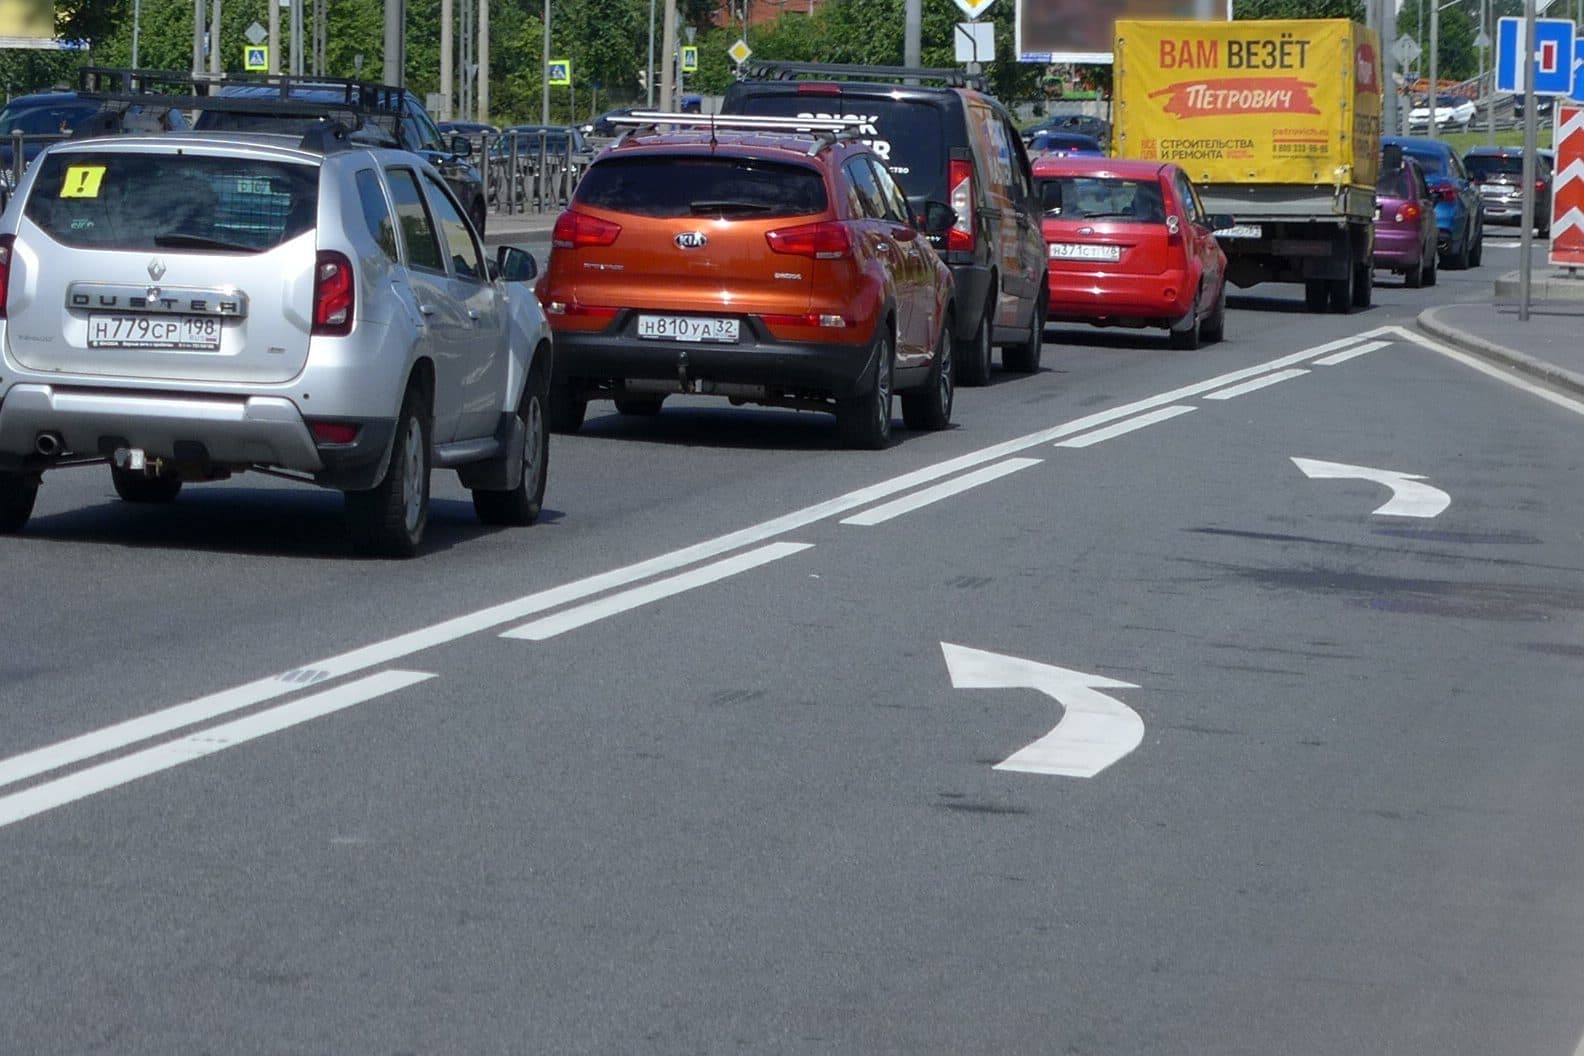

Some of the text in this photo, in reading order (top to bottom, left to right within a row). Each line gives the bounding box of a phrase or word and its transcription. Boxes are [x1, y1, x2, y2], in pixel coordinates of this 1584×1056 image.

[1159, 33, 1311, 69] ВАМ ВЕЗЁТ
[1160, 139, 1254, 150] СТРОИТЕЛЬСТВА
[1161, 151, 1169, 160] И
[1172, 150, 1223, 160] РЕМОНТА
[679, 233, 703, 246] KIA
[72, 294, 238, 313] DUSTER
[96, 318, 215, 340] Н779СР 198
[716, 320, 733, 333] 32
